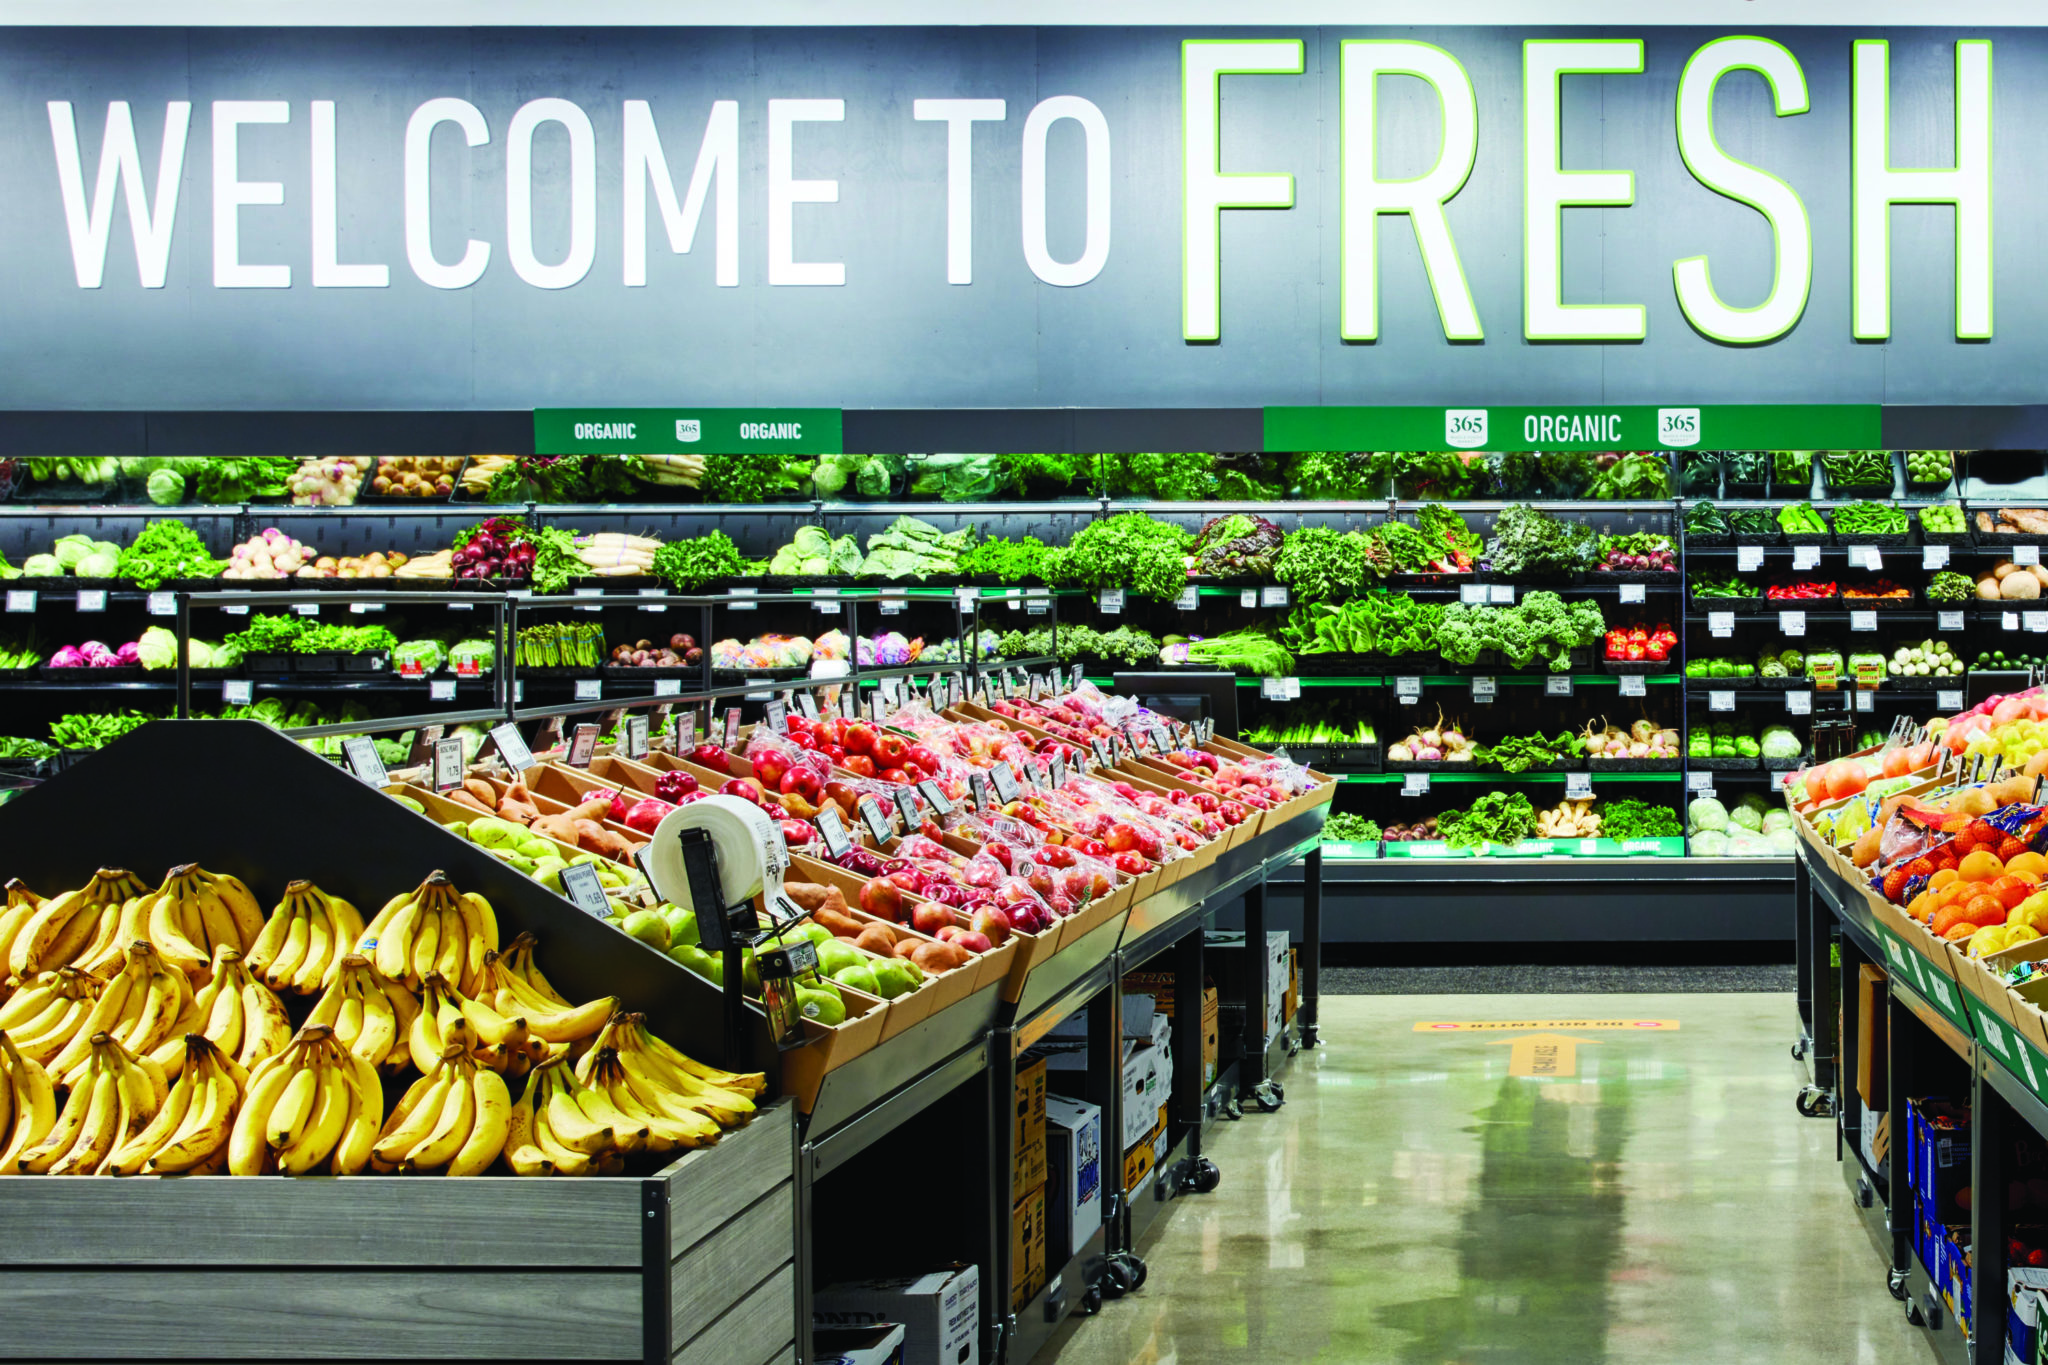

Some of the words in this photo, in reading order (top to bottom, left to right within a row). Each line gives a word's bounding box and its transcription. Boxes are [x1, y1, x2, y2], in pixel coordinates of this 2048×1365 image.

[48, 98, 847, 289] WELCOME
[912, 95, 1112, 286] TO
[1180, 35, 1995, 347] FRESH
[574, 423, 636, 439] ORGANIC
[740, 423, 802, 439] ORGANIC
[1450, 416, 1483, 433] 365
[1524, 415, 1622, 442] ORGANIC
[1663, 414, 1695, 432] 365
[1622, 842, 1661, 852] ORGANIC
